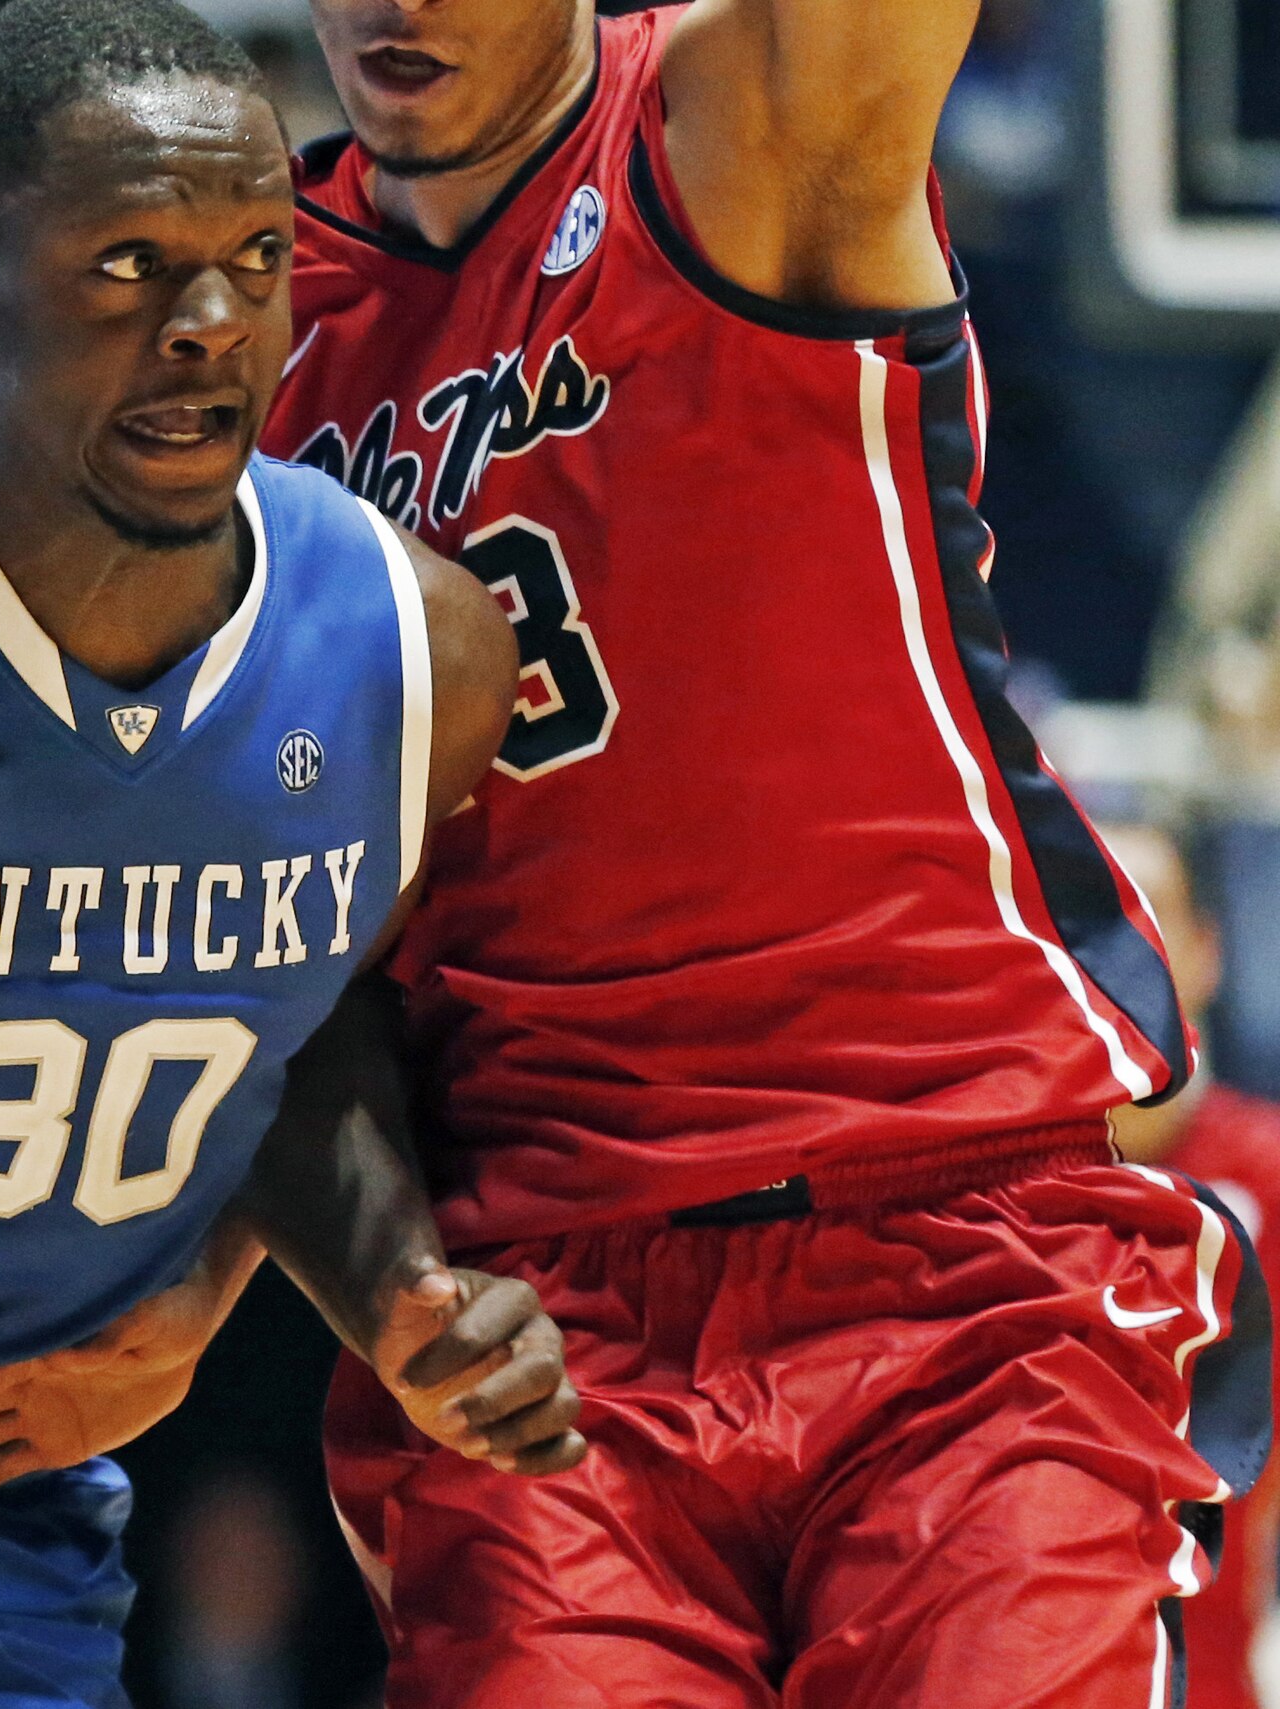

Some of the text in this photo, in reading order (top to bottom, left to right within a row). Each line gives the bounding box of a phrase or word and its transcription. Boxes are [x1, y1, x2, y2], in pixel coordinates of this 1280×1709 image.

[416, 334, 611, 532] Mss
[115, 711, 148, 736] UK
[448, 513, 620, 817] 3
[280, 735, 320, 788] SEC
